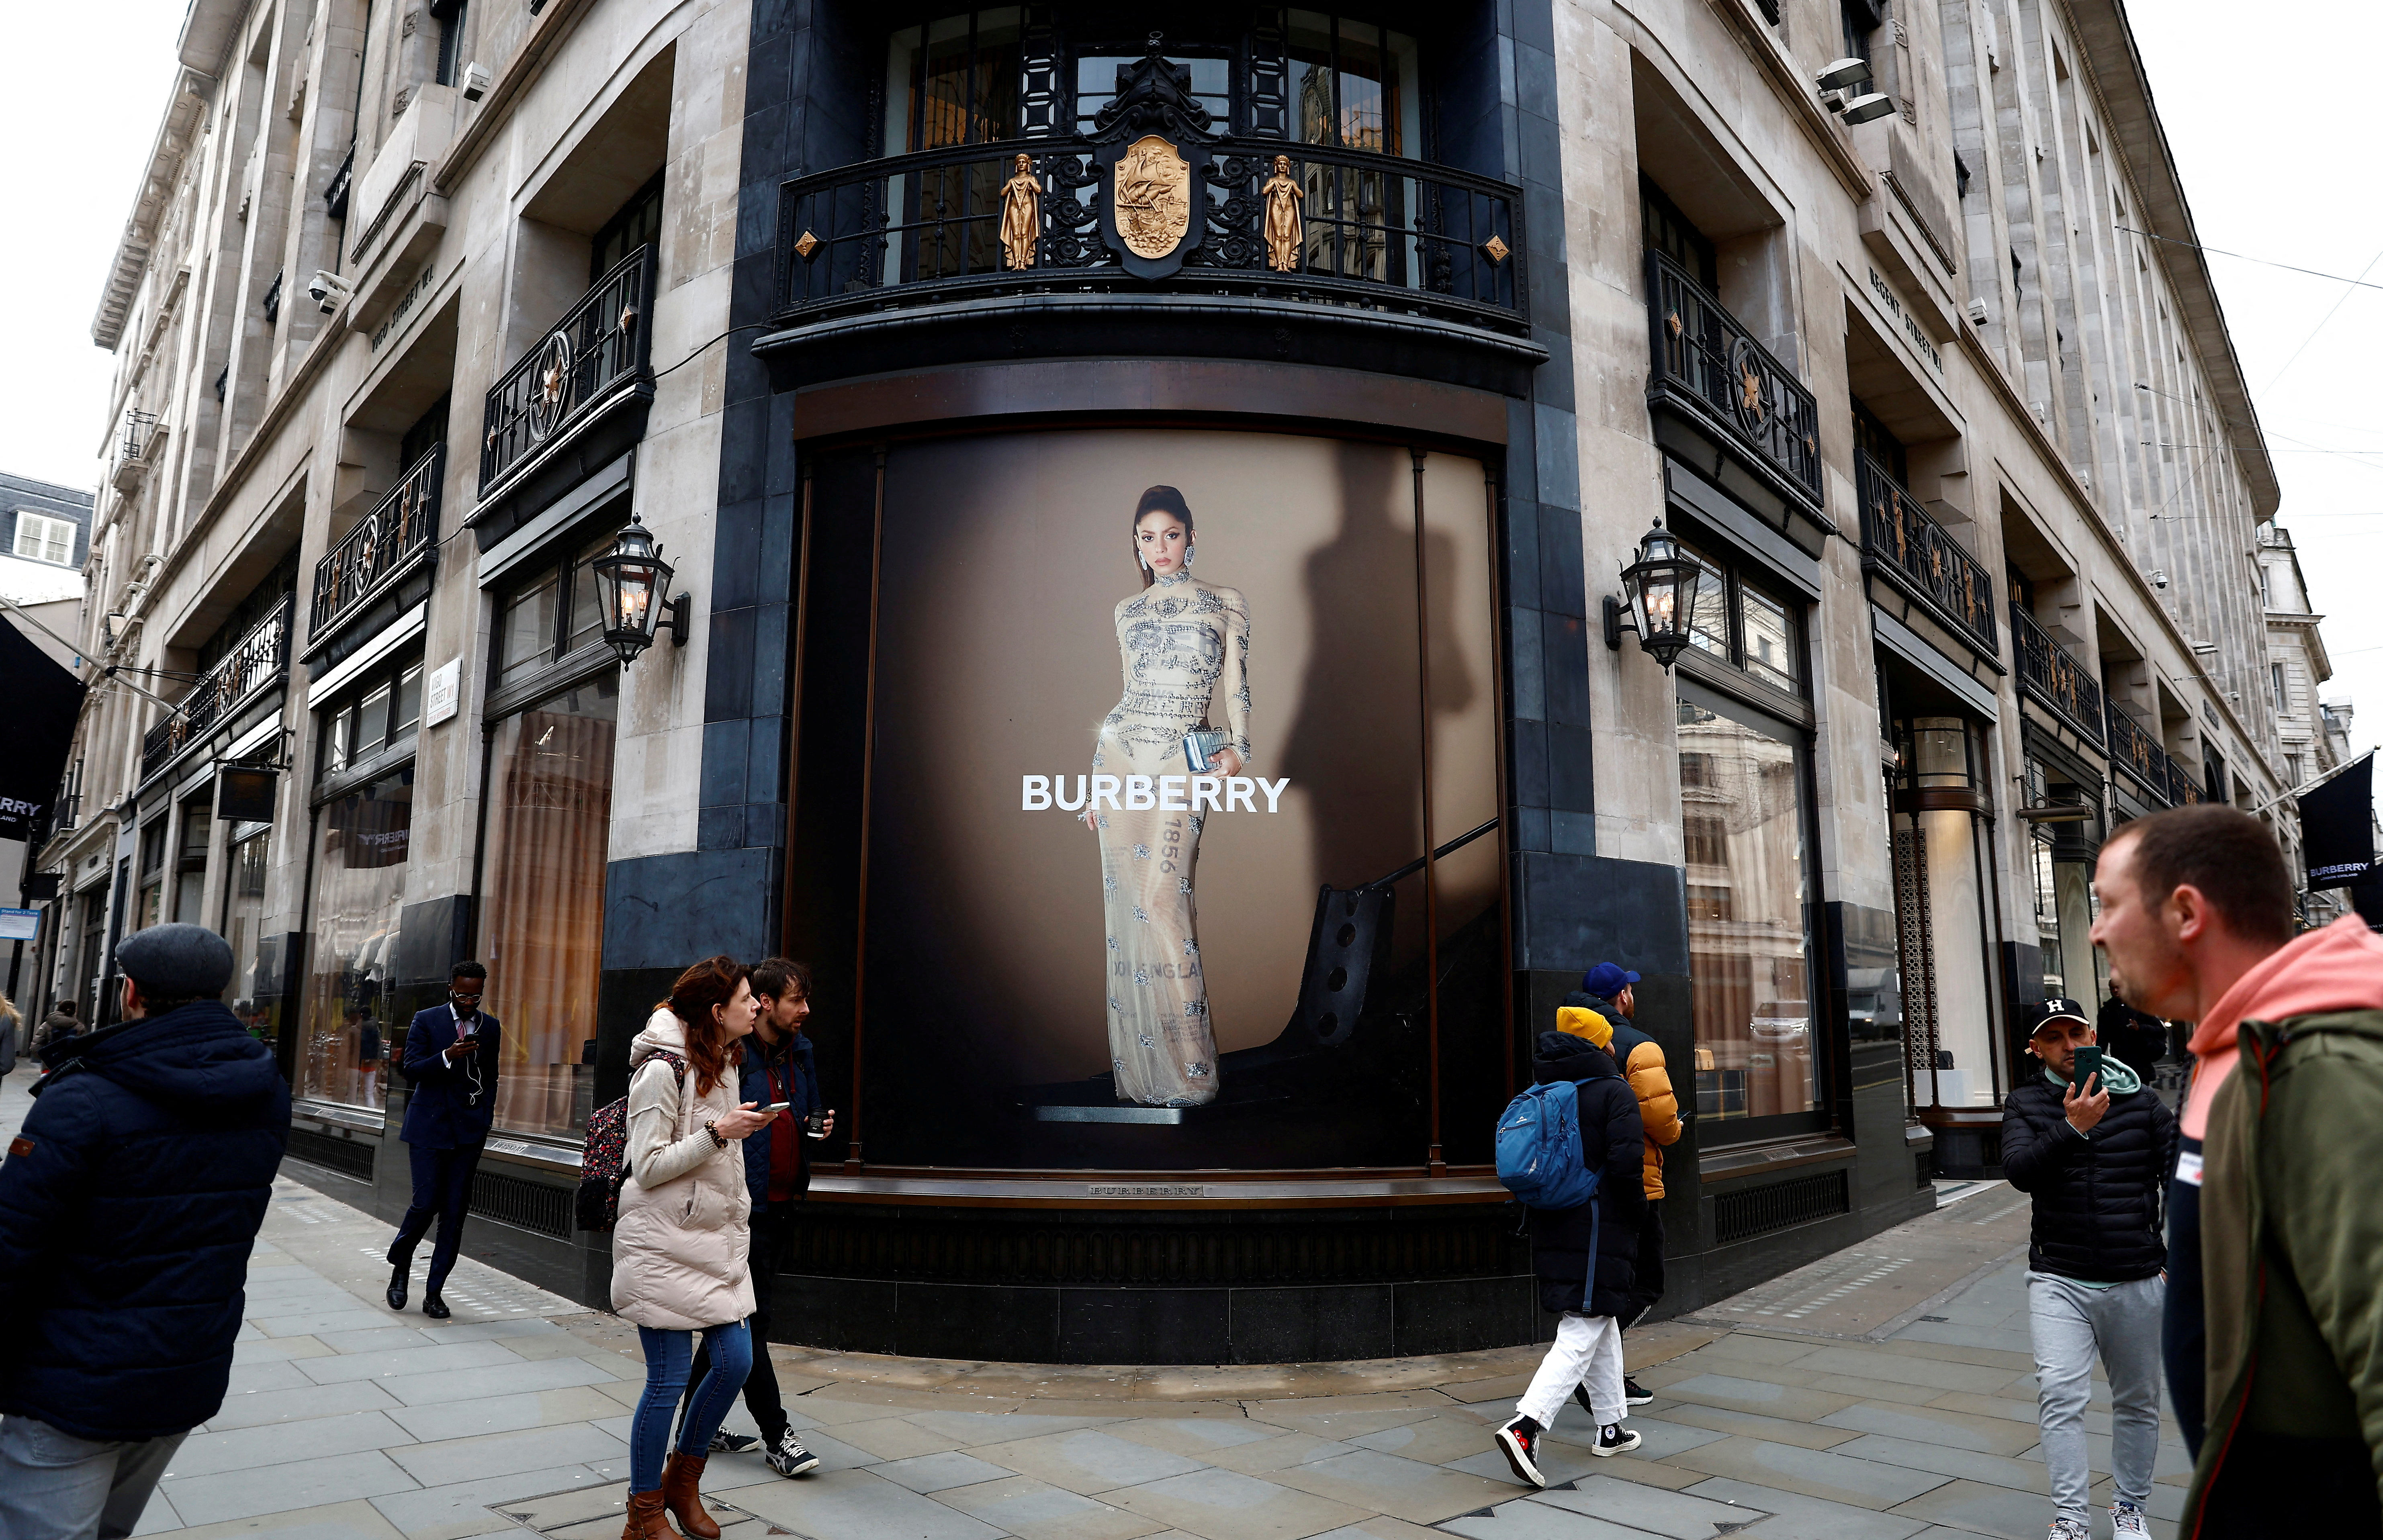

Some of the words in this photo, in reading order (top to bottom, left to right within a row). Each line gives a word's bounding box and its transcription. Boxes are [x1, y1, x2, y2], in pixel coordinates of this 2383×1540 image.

[372, 322, 388, 353] VIGO
[391, 280, 420, 329] STREET
[1869, 266, 1900, 318] REGENT
[1905, 313, 1930, 358] STREET
[432, 674, 442, 691] VIGO
[430, 687, 446, 708] STREET
[447, 683, 454, 699] W1
[0, 796, 42, 816] RRY
[1022, 774, 1291, 813] BURBERRY
[1160, 819, 1182, 873] 1856
[2310, 862, 2369, 876] BURBERRY
[2046, 999, 2065, 1013] H
